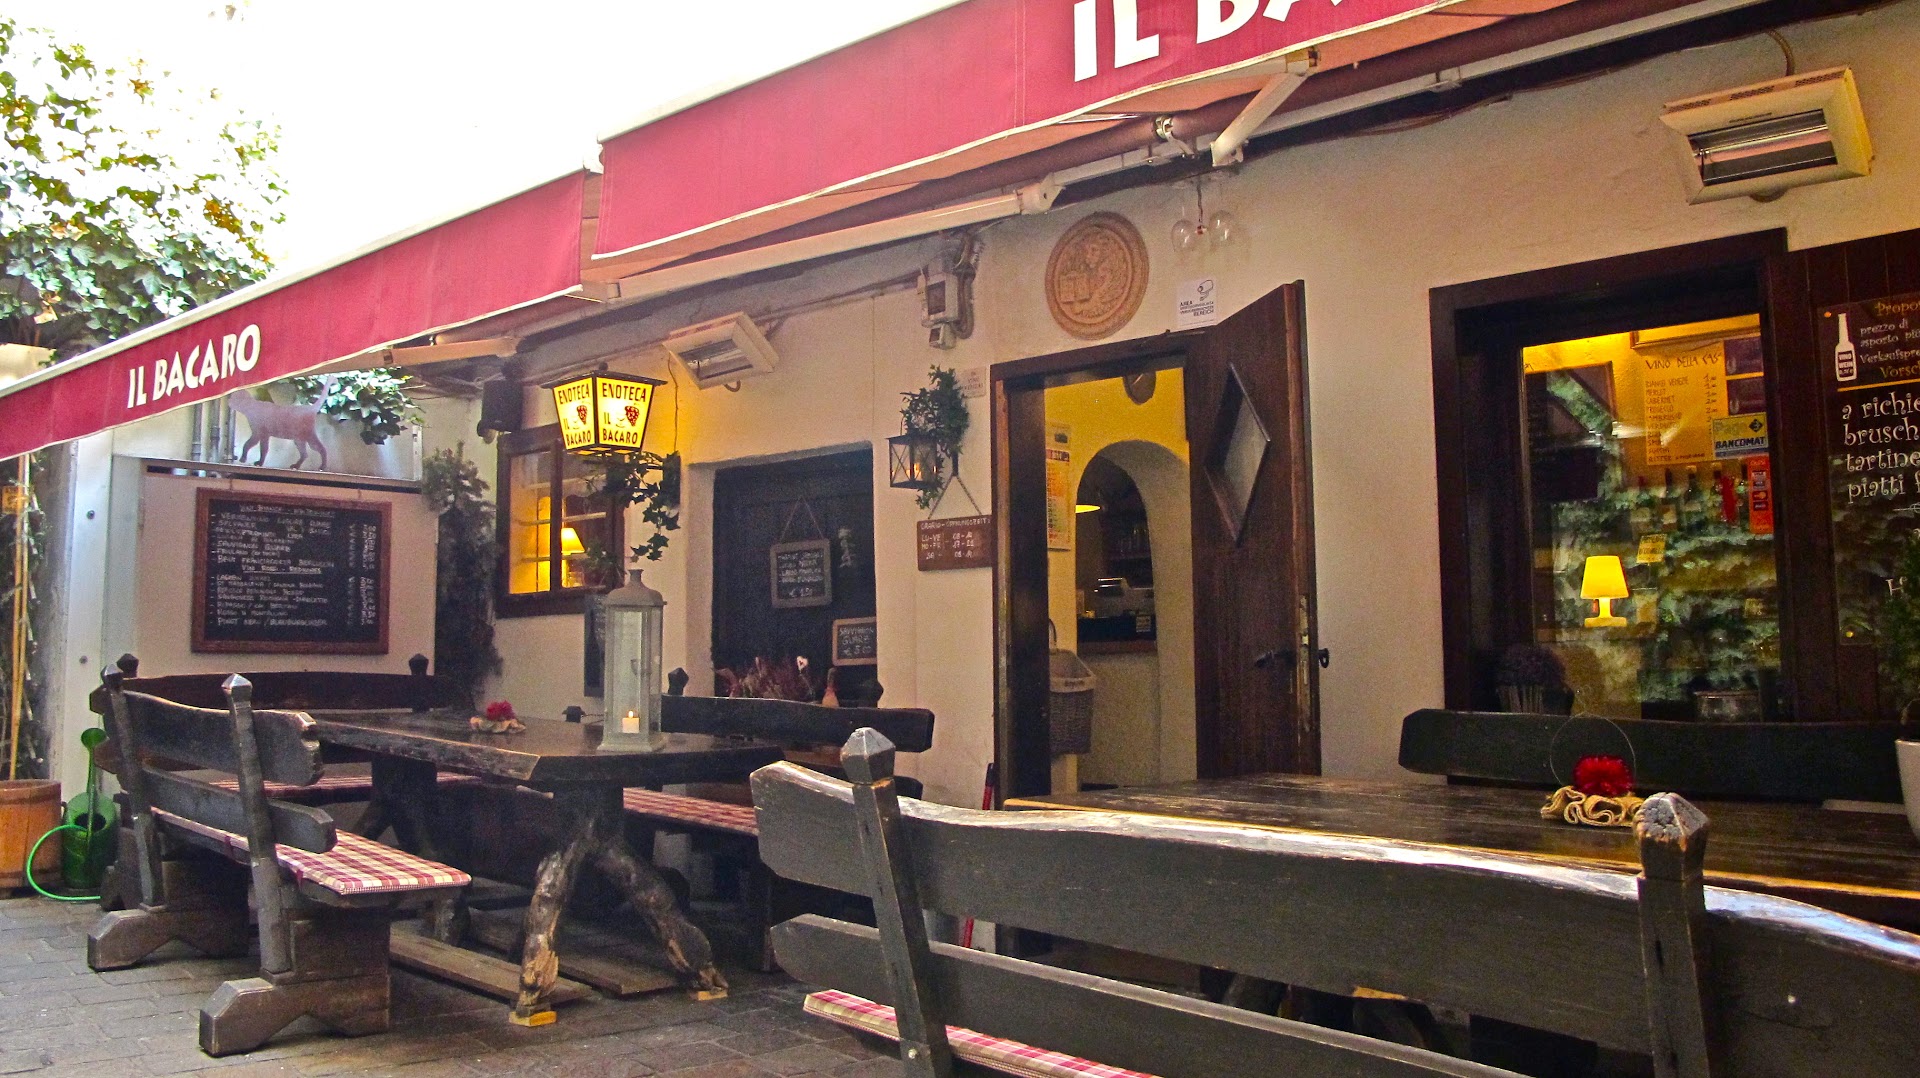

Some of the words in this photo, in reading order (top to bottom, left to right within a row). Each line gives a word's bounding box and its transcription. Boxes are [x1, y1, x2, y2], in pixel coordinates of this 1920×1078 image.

[1074, 0, 1159, 82] IL
[1875, 300, 1920, 316] Propo
[1861, 323, 1896, 337] prezzo
[1899, 317, 1908, 329] di
[1861, 334, 1899, 348] asporto
[127, 365, 147, 409] IL
[152, 324, 261, 401] BACARO
[1645, 359, 1671, 370] VINO
[1677, 355, 1699, 368] DELLA
[558, 383, 590, 404] ENOTECA
[601, 382, 647, 402] ENOTECA
[603, 412, 611, 425] IL
[1842, 404, 1853, 420] a
[563, 418, 570, 430] IL
[566, 430, 592, 447] BACARO
[602, 429, 638, 445] BACARO
[1715, 437, 1765, 449] BANCOMAT
[1845, 448, 1920, 473] tartine
[1847, 474, 1907, 504] piatti
